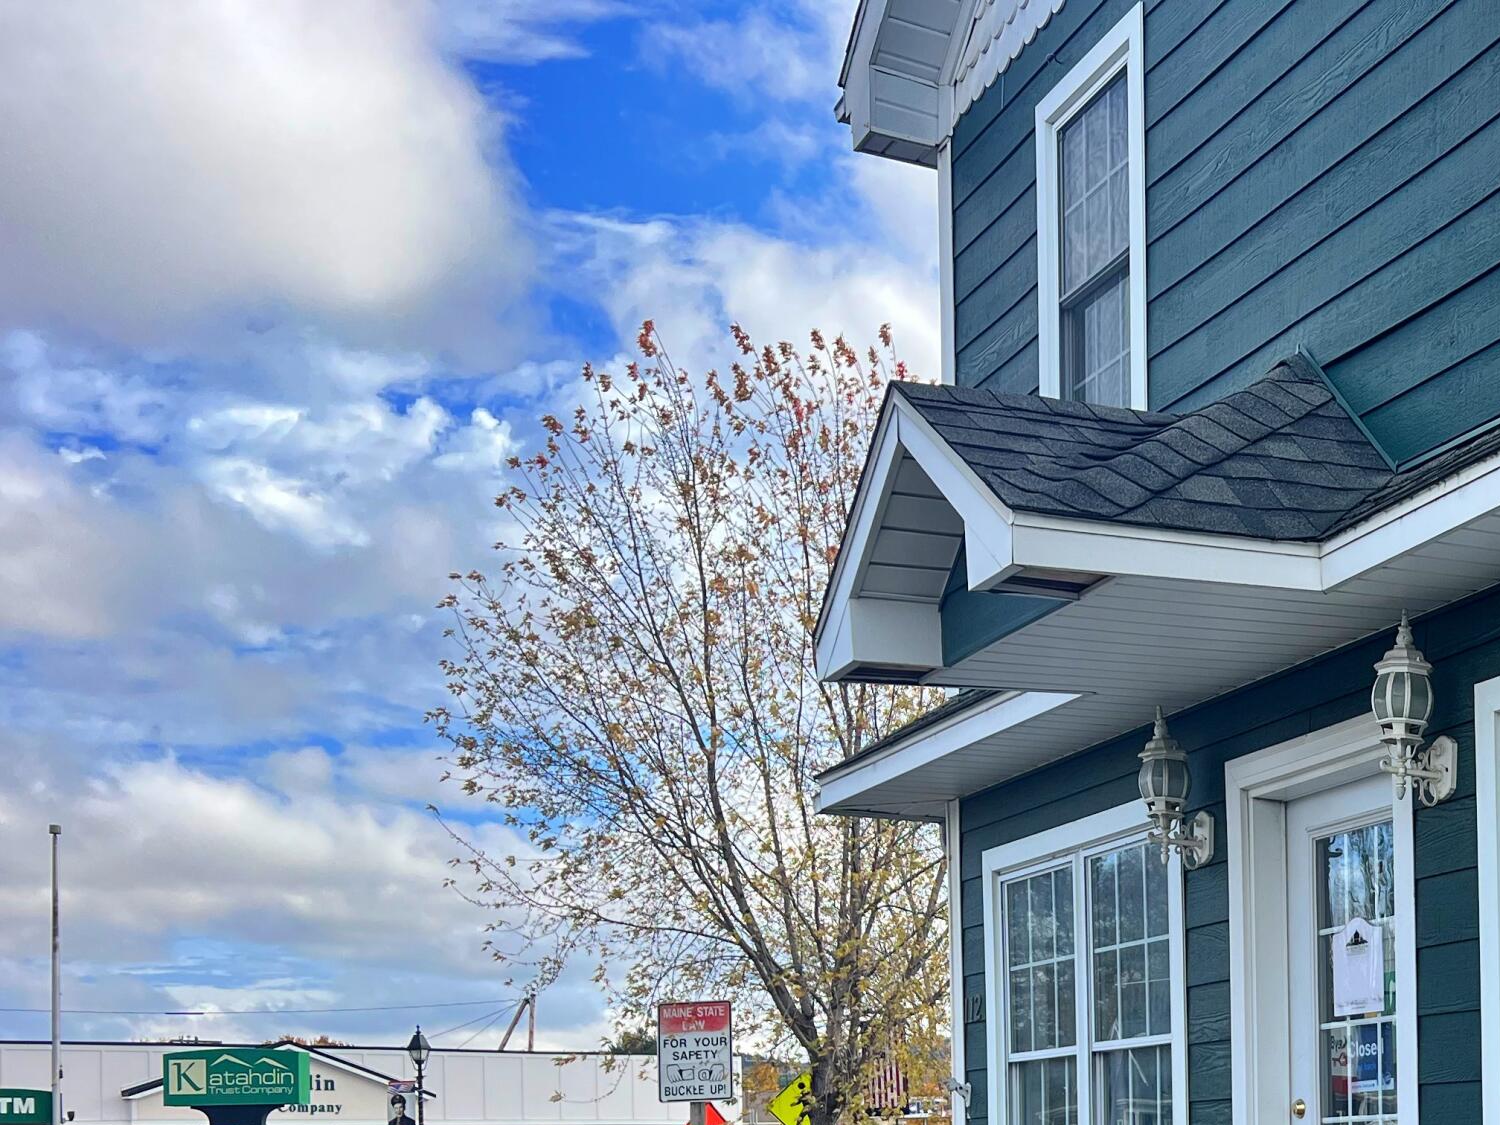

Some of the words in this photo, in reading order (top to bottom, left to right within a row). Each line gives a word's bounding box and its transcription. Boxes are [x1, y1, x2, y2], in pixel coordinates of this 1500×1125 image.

[663, 1007, 692, 1018] MAINE
[697, 1006, 725, 1017] STATE
[682, 1020, 705, 1031] LAW
[663, 1038, 687, 1048] FOR
[694, 1036, 727, 1047] YOUR
[672, 1049, 717, 1061] SAFETY
[171, 1061, 294, 1092] Katahdin
[208, 1086, 240, 1095] Trust
[241, 1085, 293, 1096] Company
[664, 1085, 704, 1097] BUCKLE
[710, 1084, 726, 1095] UP!
[0, 1097, 35, 1114] TM
